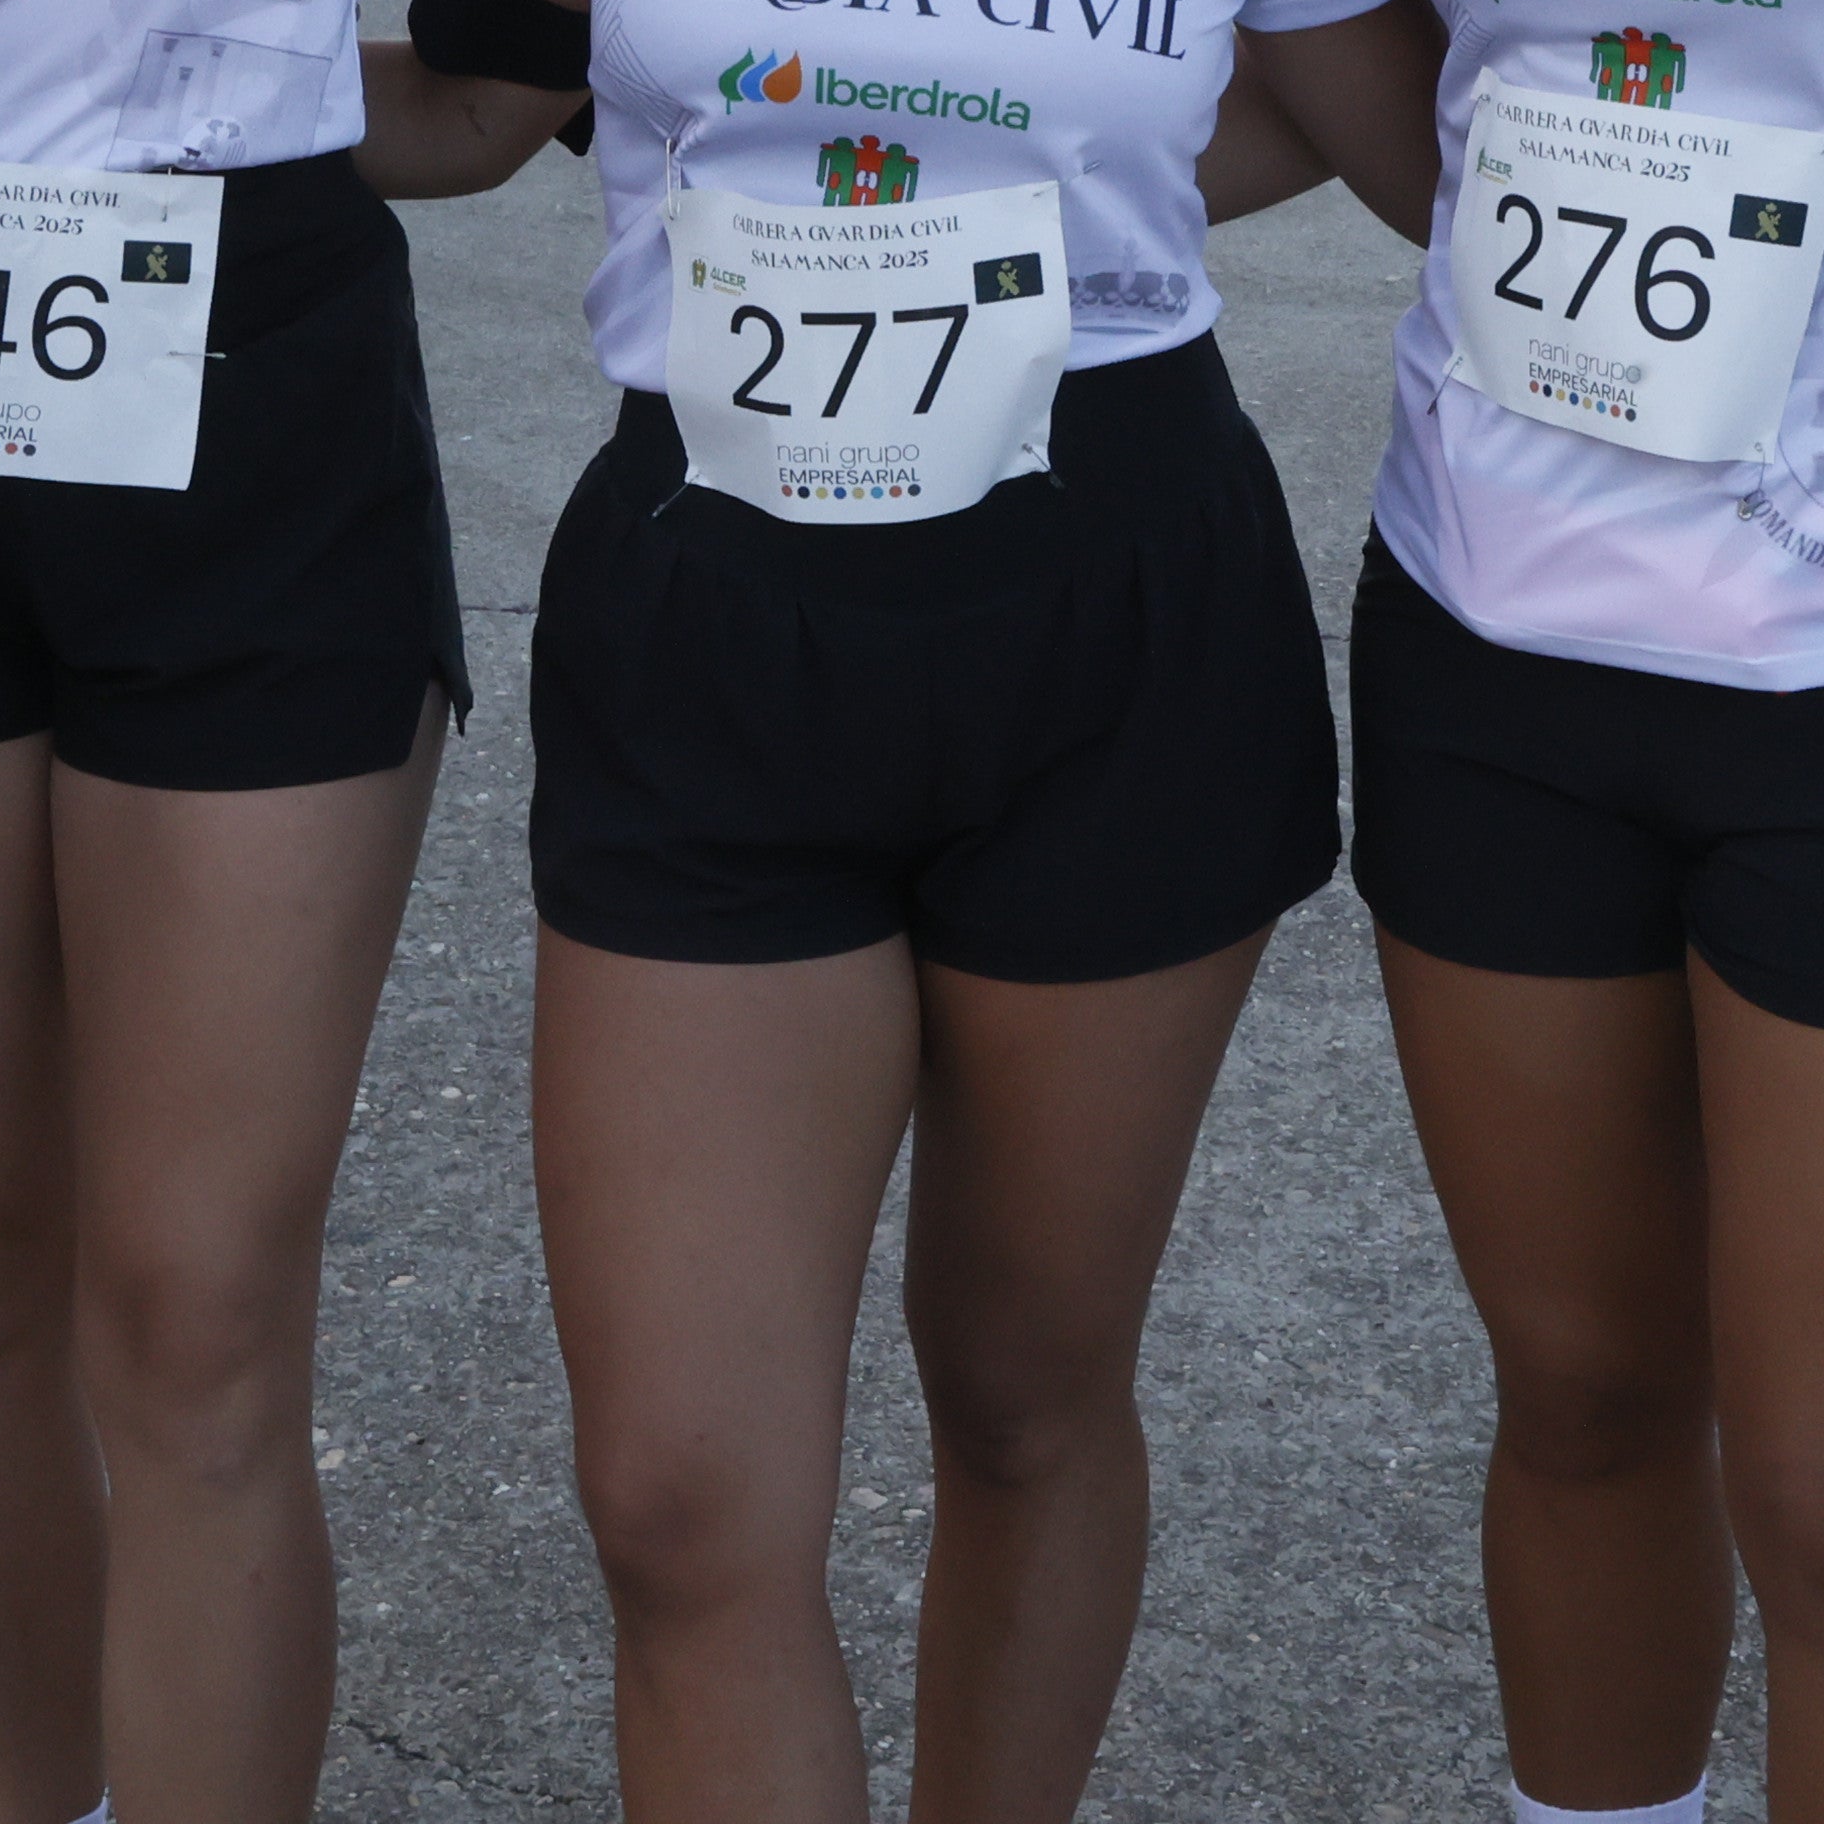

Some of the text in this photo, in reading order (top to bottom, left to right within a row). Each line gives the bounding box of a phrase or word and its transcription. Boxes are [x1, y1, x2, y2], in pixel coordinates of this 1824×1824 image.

[814, 66, 1032, 133] Iberdrola
[1495, 101, 1573, 133] CARRERA
[1518, 137, 1692, 183] SALAMANCA 2025
[33, 214, 85, 236] 2025
[732, 213, 802, 242] CARRERA
[750, 247, 930, 272] SALAMANCA 2025
[1493, 192, 1716, 342] 276
[729, 303, 970, 419] 277
[1528, 335, 1643, 385] nani grupo
[1528, 361, 1639, 409] EMPRESARIAL
[776, 441, 921, 469] nani grupo
[778, 466, 922, 486] EMPRESARIAL
